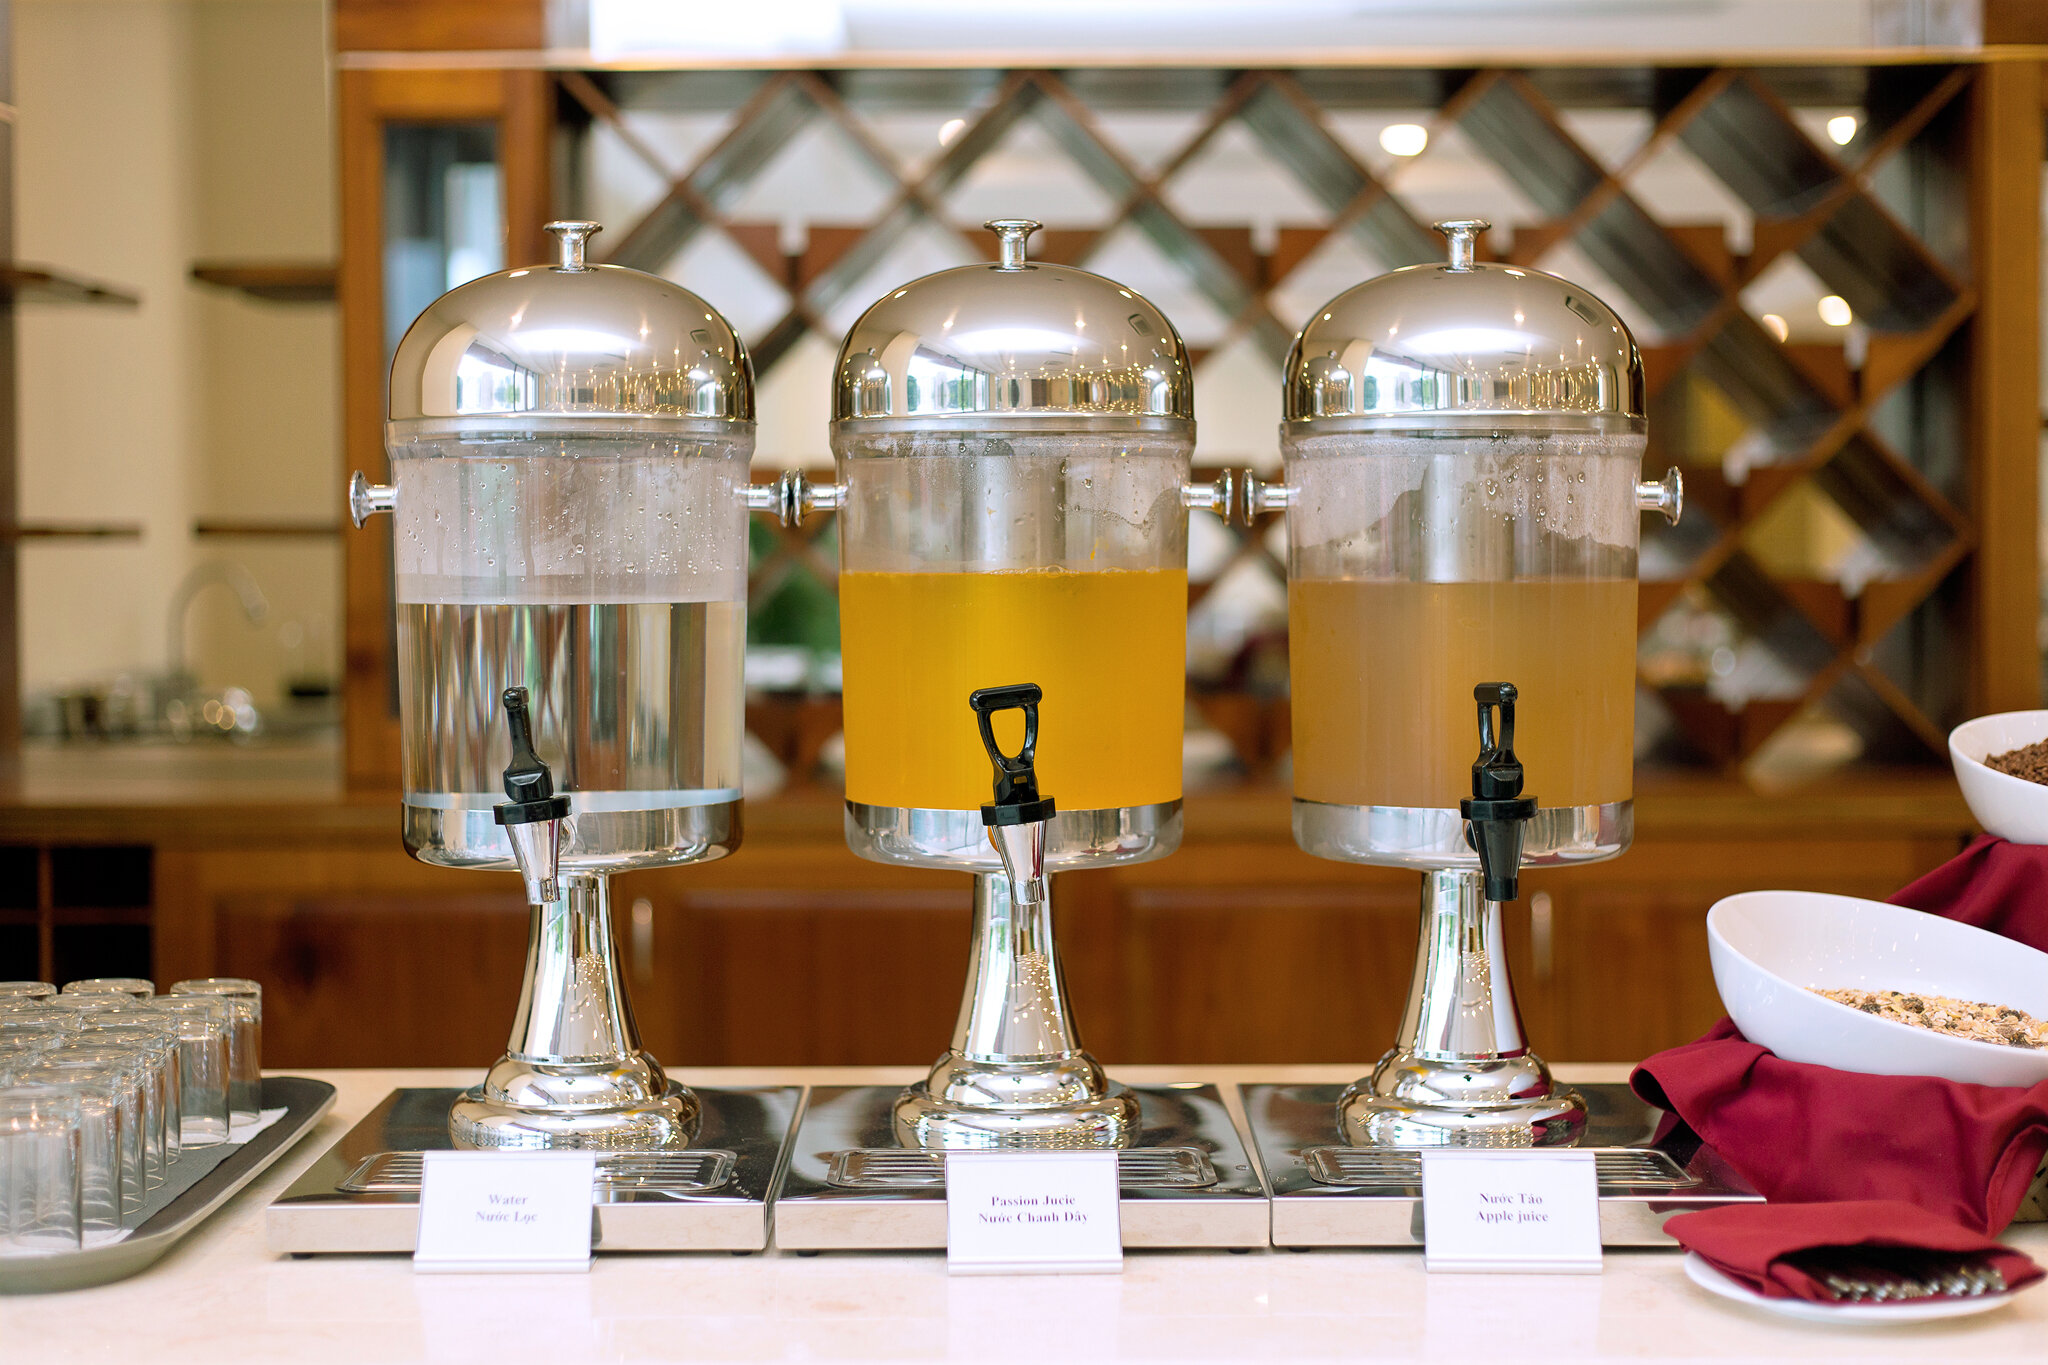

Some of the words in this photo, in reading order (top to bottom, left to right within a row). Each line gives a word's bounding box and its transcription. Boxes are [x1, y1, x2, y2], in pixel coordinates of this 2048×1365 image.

[488, 1194, 528, 1205] Water
[991, 1195, 1039, 1206] Passion
[1042, 1194, 1076, 1205] Jucie
[1017, 1212, 1060, 1223] Chanh
[1475, 1210, 1514, 1224] Apple
[1517, 1210, 1548, 1224] juice
